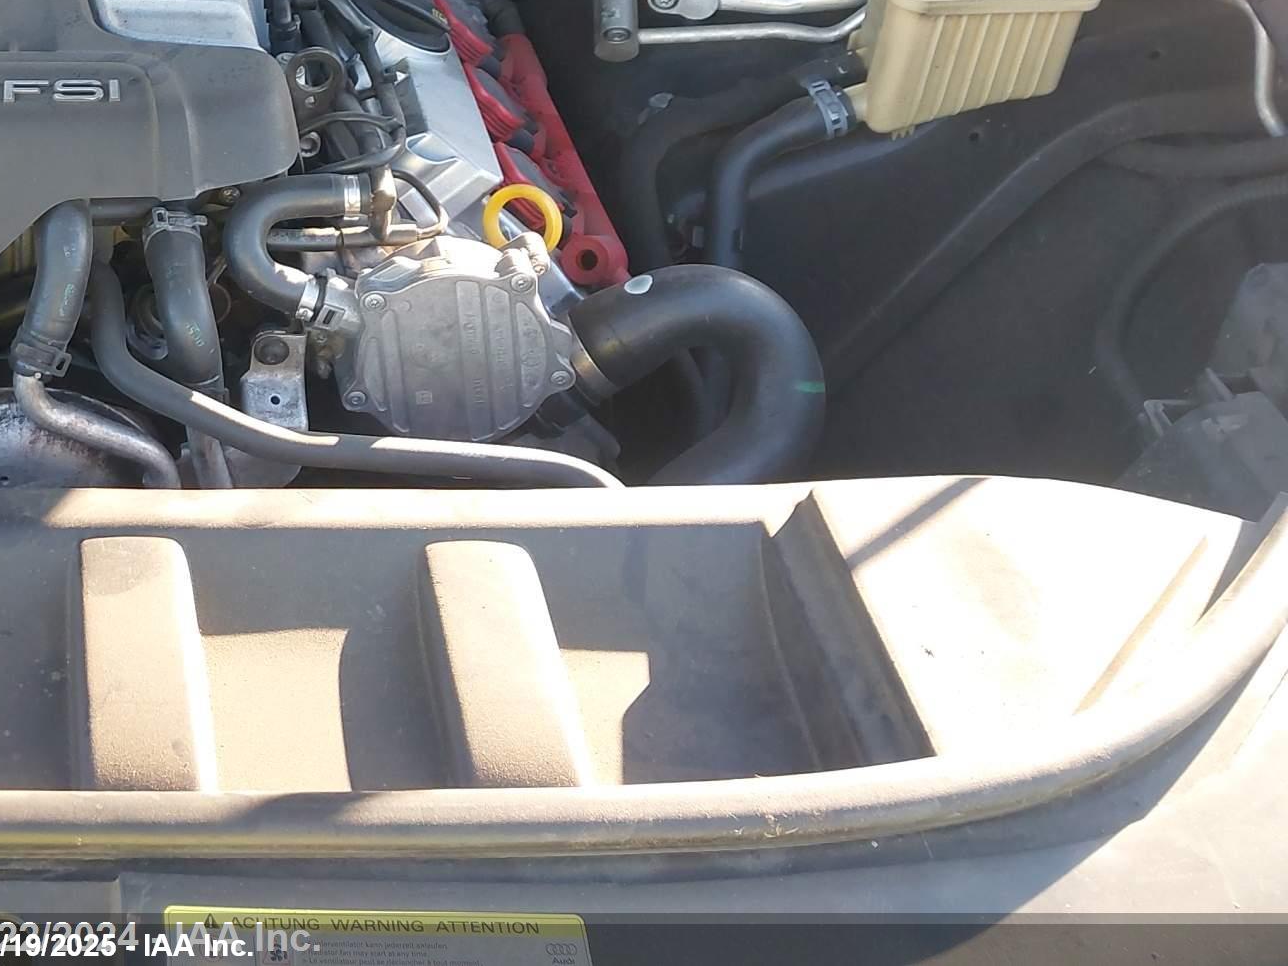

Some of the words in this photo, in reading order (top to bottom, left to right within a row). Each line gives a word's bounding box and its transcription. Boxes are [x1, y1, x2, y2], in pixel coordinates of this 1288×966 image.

[231, 916, 320, 931] ACHTUNG
[330, 918, 425, 933] WARNING
[435, 920, 540, 934] ATTENTION
